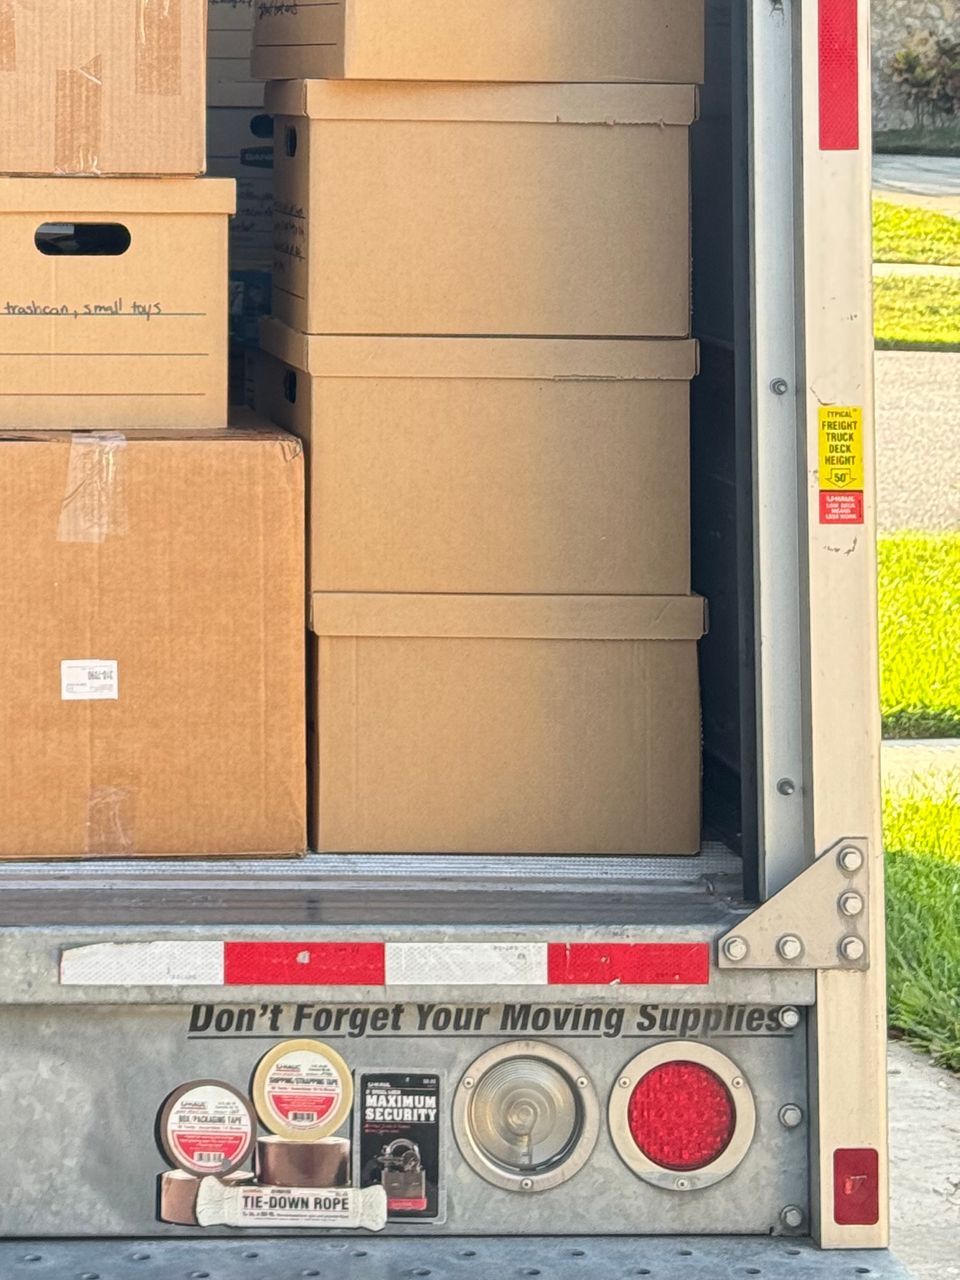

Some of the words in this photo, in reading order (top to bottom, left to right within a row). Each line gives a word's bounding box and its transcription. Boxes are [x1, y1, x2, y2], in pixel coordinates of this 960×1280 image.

[83, 297, 122, 316] small
[131, 300, 162, 321] toys
[827, 410, 852, 418] TYPICAL
[822, 420, 857, 430] FREIGHT
[826, 432, 854, 442] TRUCK
[829, 444, 851, 453] DECK
[825, 456, 855, 465] HEIGHT
[190, 1004, 283, 1032] Don't
[292, 1004, 404, 1038] Forget
[415, 1004, 489, 1032] Your
[500, 1004, 625, 1038] Moving
[637, 1004, 781, 1039] Supplies
[365, 1095, 436, 1108] MAXIMUM
[365, 1108, 437, 1121] SECURITY
[242, 1195, 309, 1209] TIE-DOWN
[314, 1197, 349, 1210] ROPE
